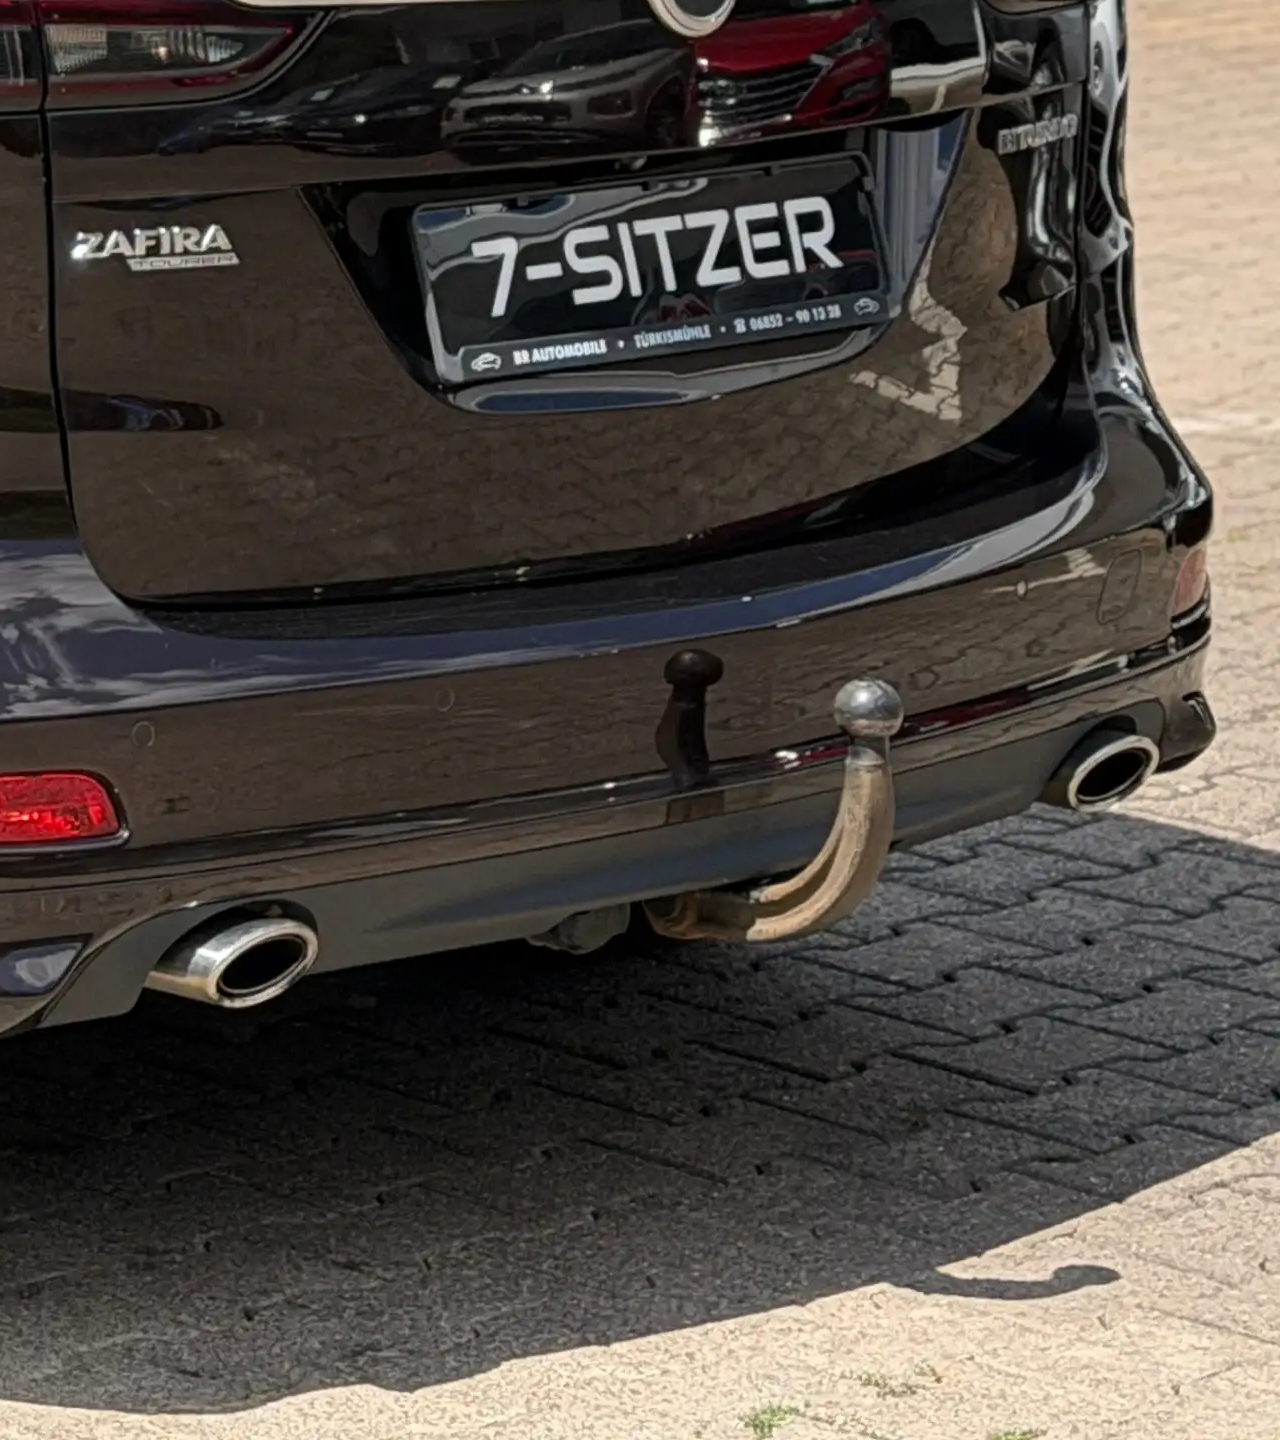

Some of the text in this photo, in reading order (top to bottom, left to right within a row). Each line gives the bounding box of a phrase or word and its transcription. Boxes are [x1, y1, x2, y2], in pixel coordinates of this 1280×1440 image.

[71, 224, 232, 260] ZAFIRA
[470, 195, 844, 318] 7-SITZER
[132, 255, 234, 269] TOURER
[531, 338, 608, 363] AUTOMOBILE
